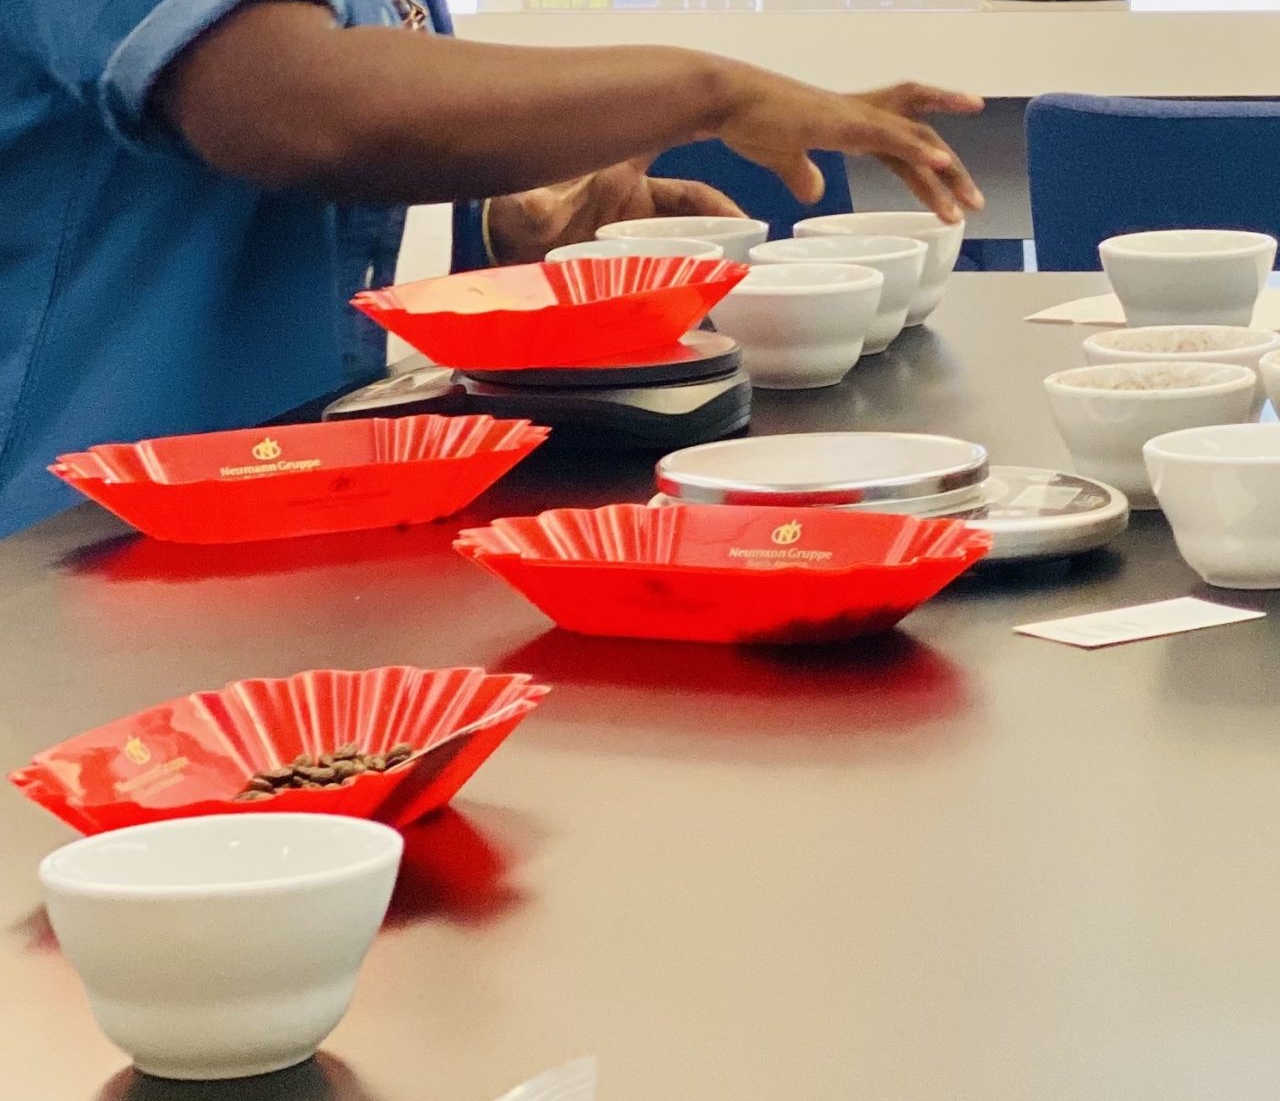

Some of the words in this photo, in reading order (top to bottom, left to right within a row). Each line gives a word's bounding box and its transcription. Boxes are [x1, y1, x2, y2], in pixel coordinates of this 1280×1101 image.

[220, 462, 277, 477] Neumann
[278, 458, 321, 473] Gruppe
[728, 548, 786, 558] Neumann
[788, 548, 833, 561] Gruppe
